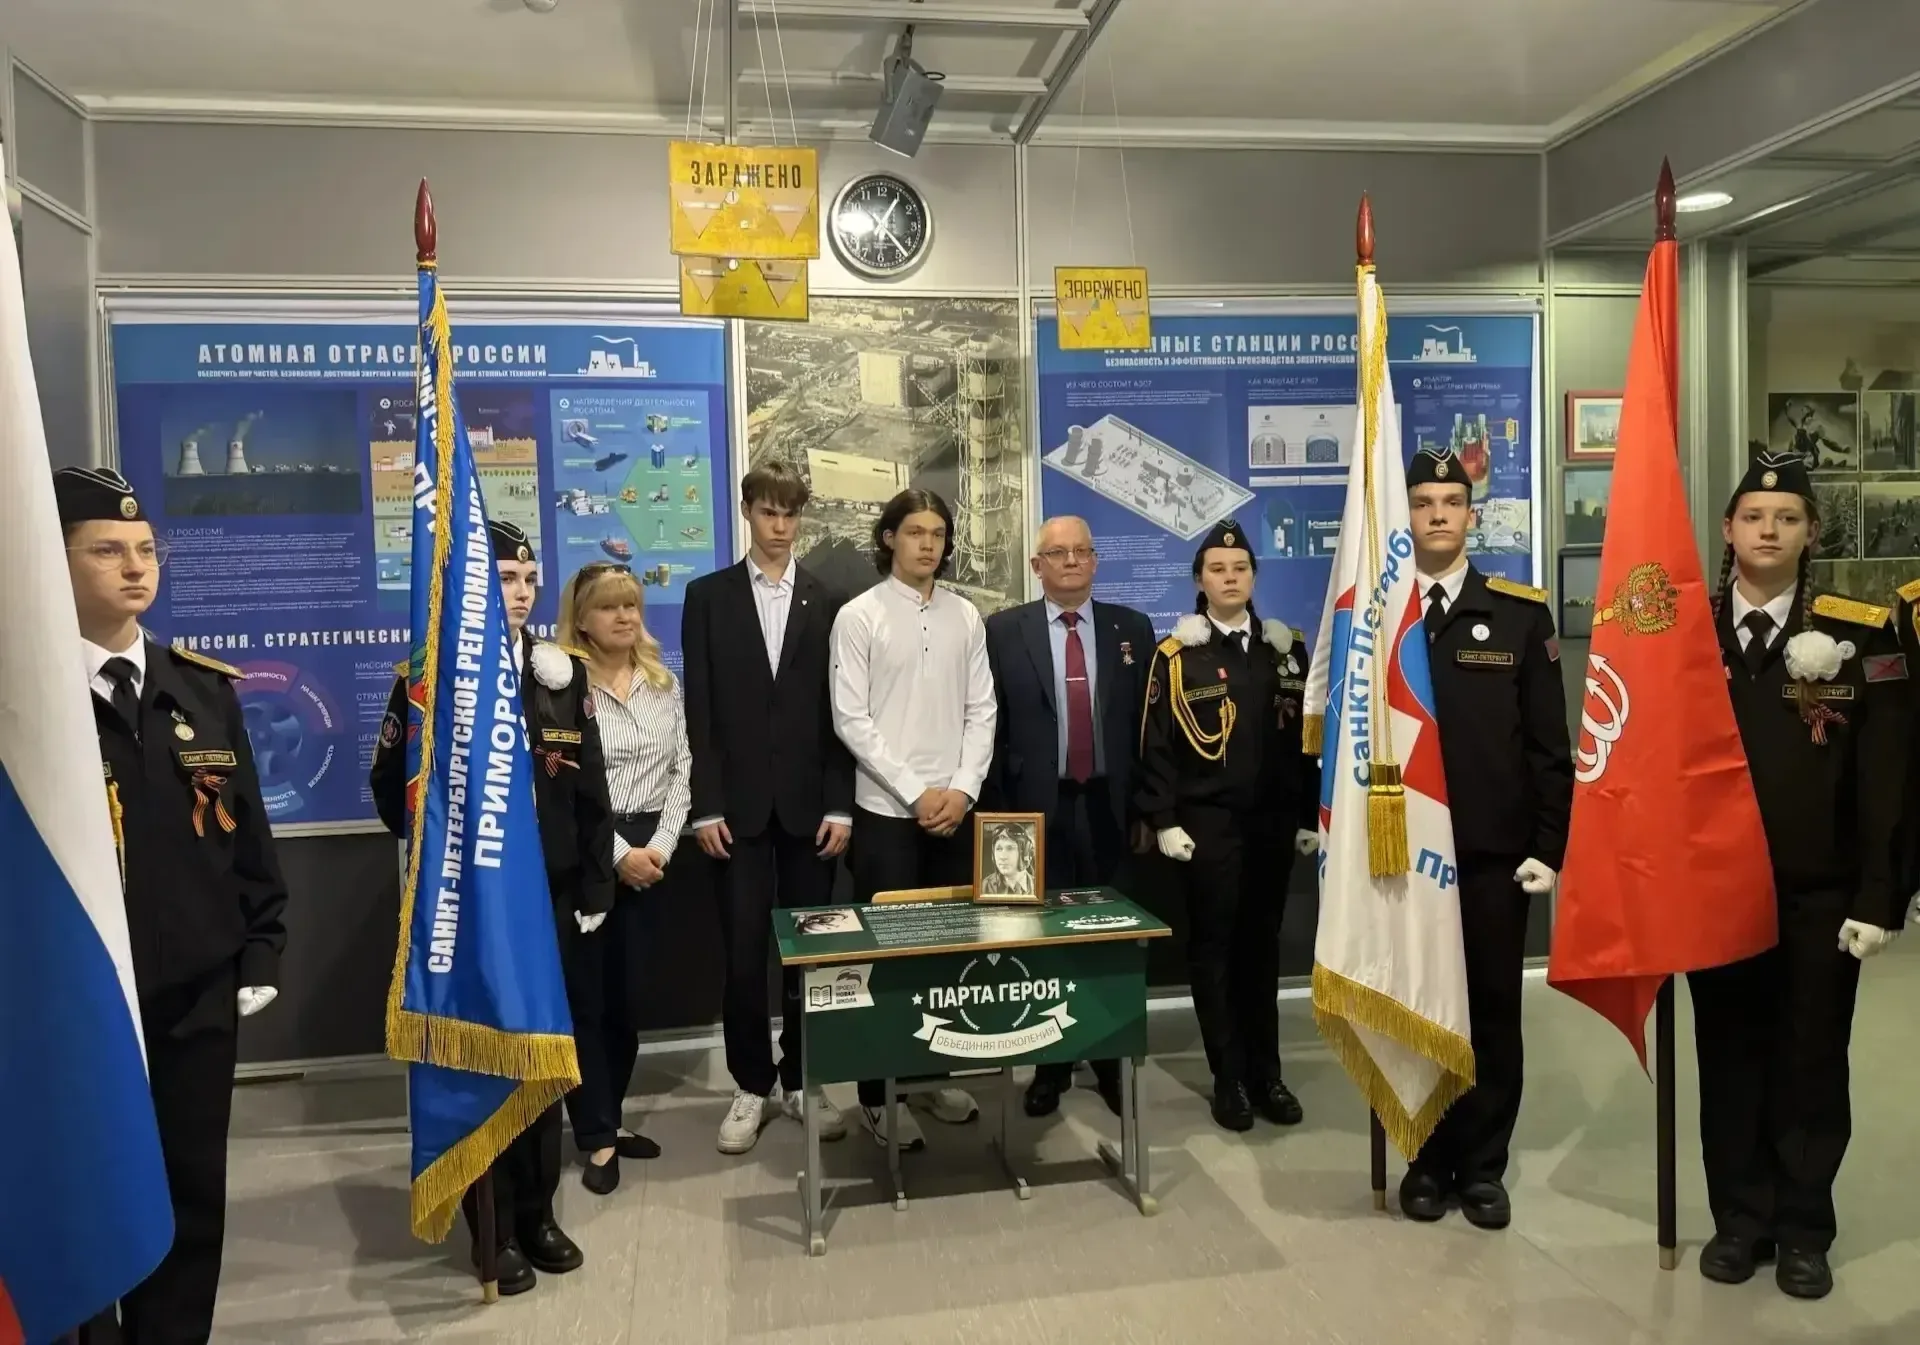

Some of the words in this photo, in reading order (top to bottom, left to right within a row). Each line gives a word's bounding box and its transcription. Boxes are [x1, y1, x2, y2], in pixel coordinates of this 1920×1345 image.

[691, 160, 801, 188] ЗАРАЖЕНО
[861, 190, 870, 200] 11
[877, 187, 887, 197] 12
[905, 204, 912, 214] 2
[911, 222, 917, 231] 3
[905, 236, 911, 246] 4
[861, 248, 868, 257] 7
[895, 249, 901, 259] 5
[877, 254, 884, 262] 6
[1064, 280, 1142, 300] ЗАРАЖЕНО
[1211, 334, 1301, 354] СТАНЦИИ
[1311, 334, 1357, 352] РОСС
[199, 344, 316, 363] АТОМНАЯ
[328, 345, 420, 364] ОТРАСЛ
[453, 345, 547, 364] РОССИИ
[1106, 357, 1162, 366] БЕЗОПАСНОСТЬ
[1164, 357, 1170, 365] И
[1171, 356, 1235, 365] ЭФФЕКТИВНОСТЬ
[1237, 356, 1295, 364] ПРОИЗВОДСТВА
[573, 398, 632, 407] НАПРАВЛЕНИЯ
[634, 398, 696, 407] ДЕЯТЕЛЬНОСТИ
[176, 526, 224, 536] РОСАТОМЕ
[172, 634, 256, 650] МИССИЯ.
[264, 628, 412, 648] СТРАТЕГИЧЕСКИ
[1460, 653, 1509, 662] САНКТ-ПЕТЕРБУРГ
[355, 661, 392, 670] МИССИЯ
[428, 676, 480, 974] САНКТ-ПЕТЕРБУРГСКОЕ
[929, 985, 995, 1009] ПАРТА
[998, 978, 1060, 1003] ГЕРОЯ
[936, 1035, 996, 1051] ОБЪЕДИНЯЯ
[998, 1026, 1057, 1050] ПОКОЛЕНИЯ
